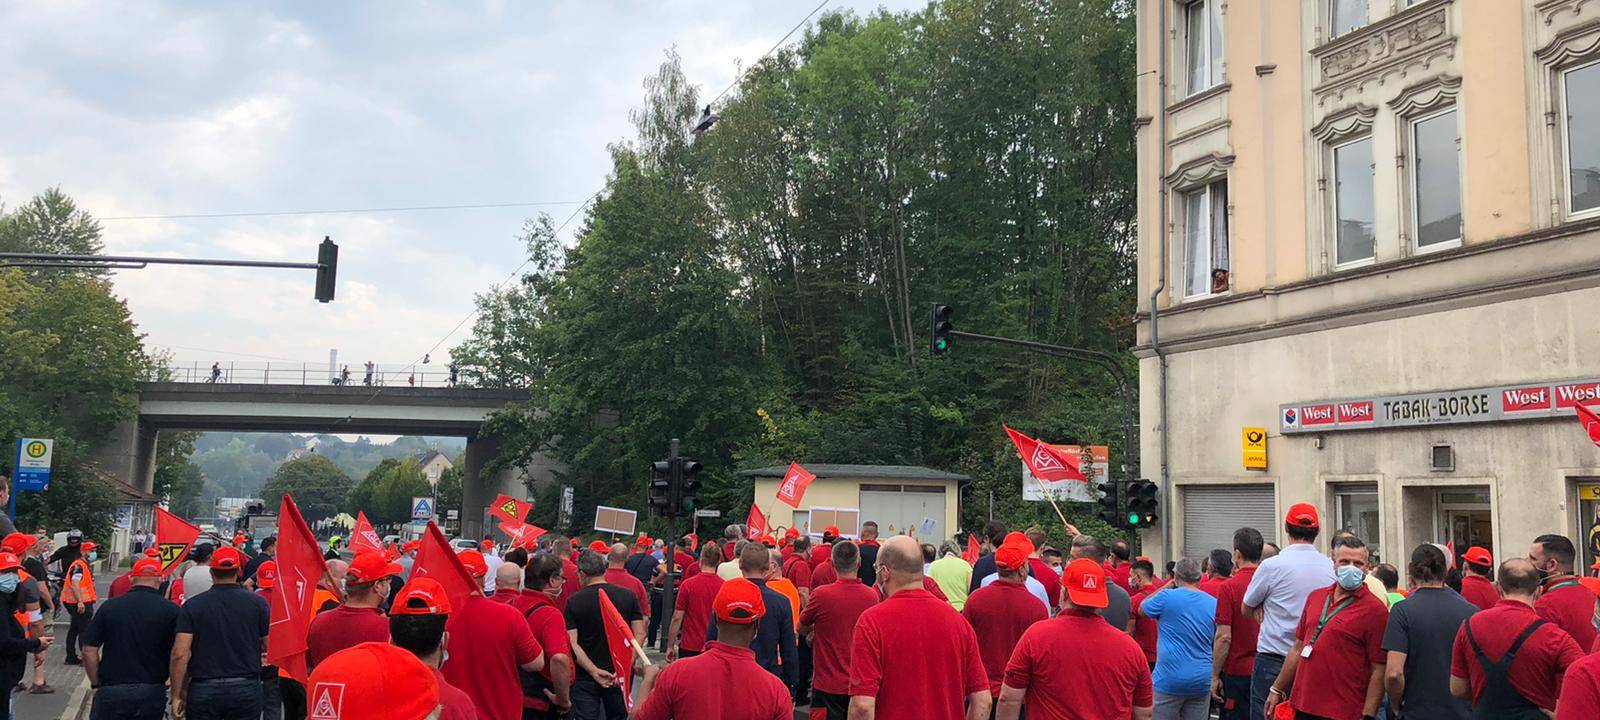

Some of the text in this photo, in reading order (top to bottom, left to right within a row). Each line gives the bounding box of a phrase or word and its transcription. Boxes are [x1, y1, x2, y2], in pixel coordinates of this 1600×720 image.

[1505, 384, 1600, 405] West West
[1303, 403, 1369, 419] West West
